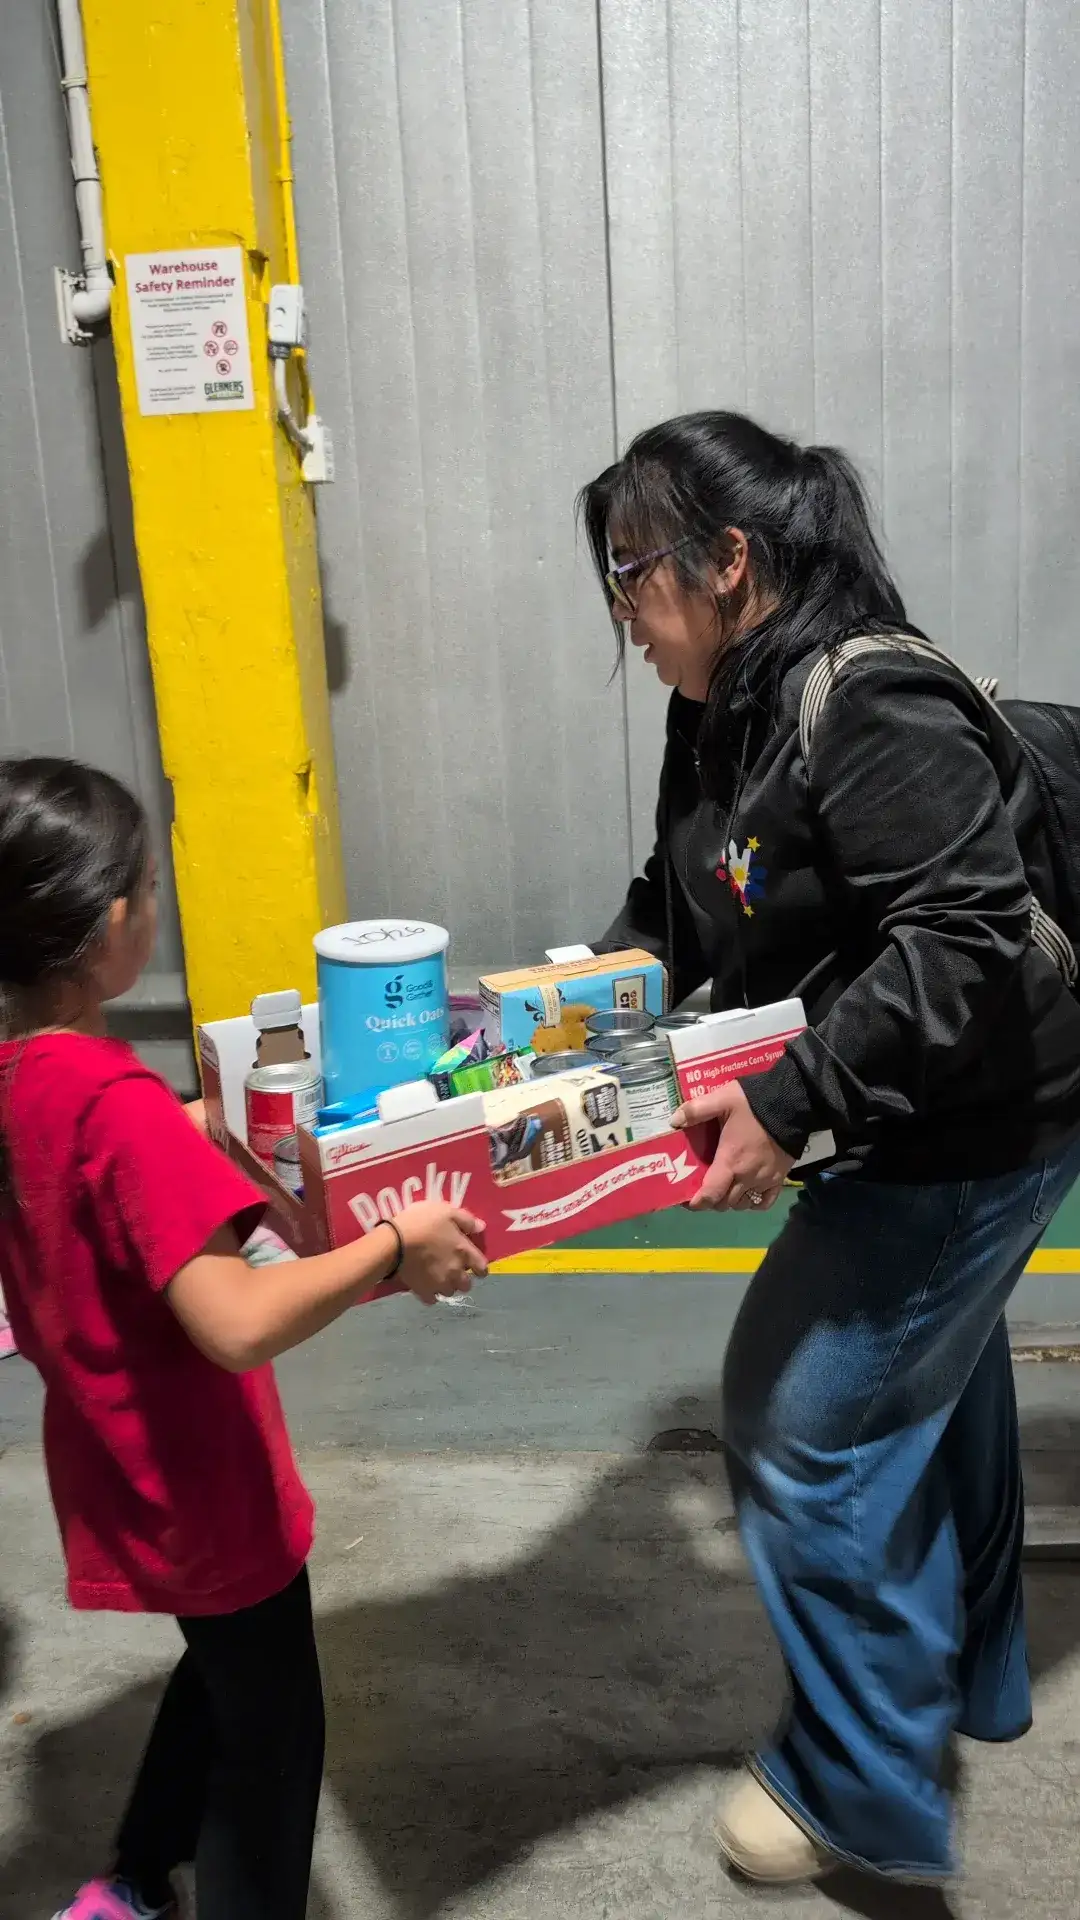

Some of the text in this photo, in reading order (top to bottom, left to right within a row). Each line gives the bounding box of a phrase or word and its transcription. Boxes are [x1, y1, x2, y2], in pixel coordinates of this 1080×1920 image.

[148, 261, 218, 276] Warehouse
[135, 276, 236, 295] Safety Reminder
[365, 1012, 417, 1033] Quick
[685, 1069, 702, 1084] NO
[748, 1055, 765, 1067] Corn
[689, 1085, 706, 1099] NO
[519, 1156, 667, 1225] Perfect snack for on-the-go!
